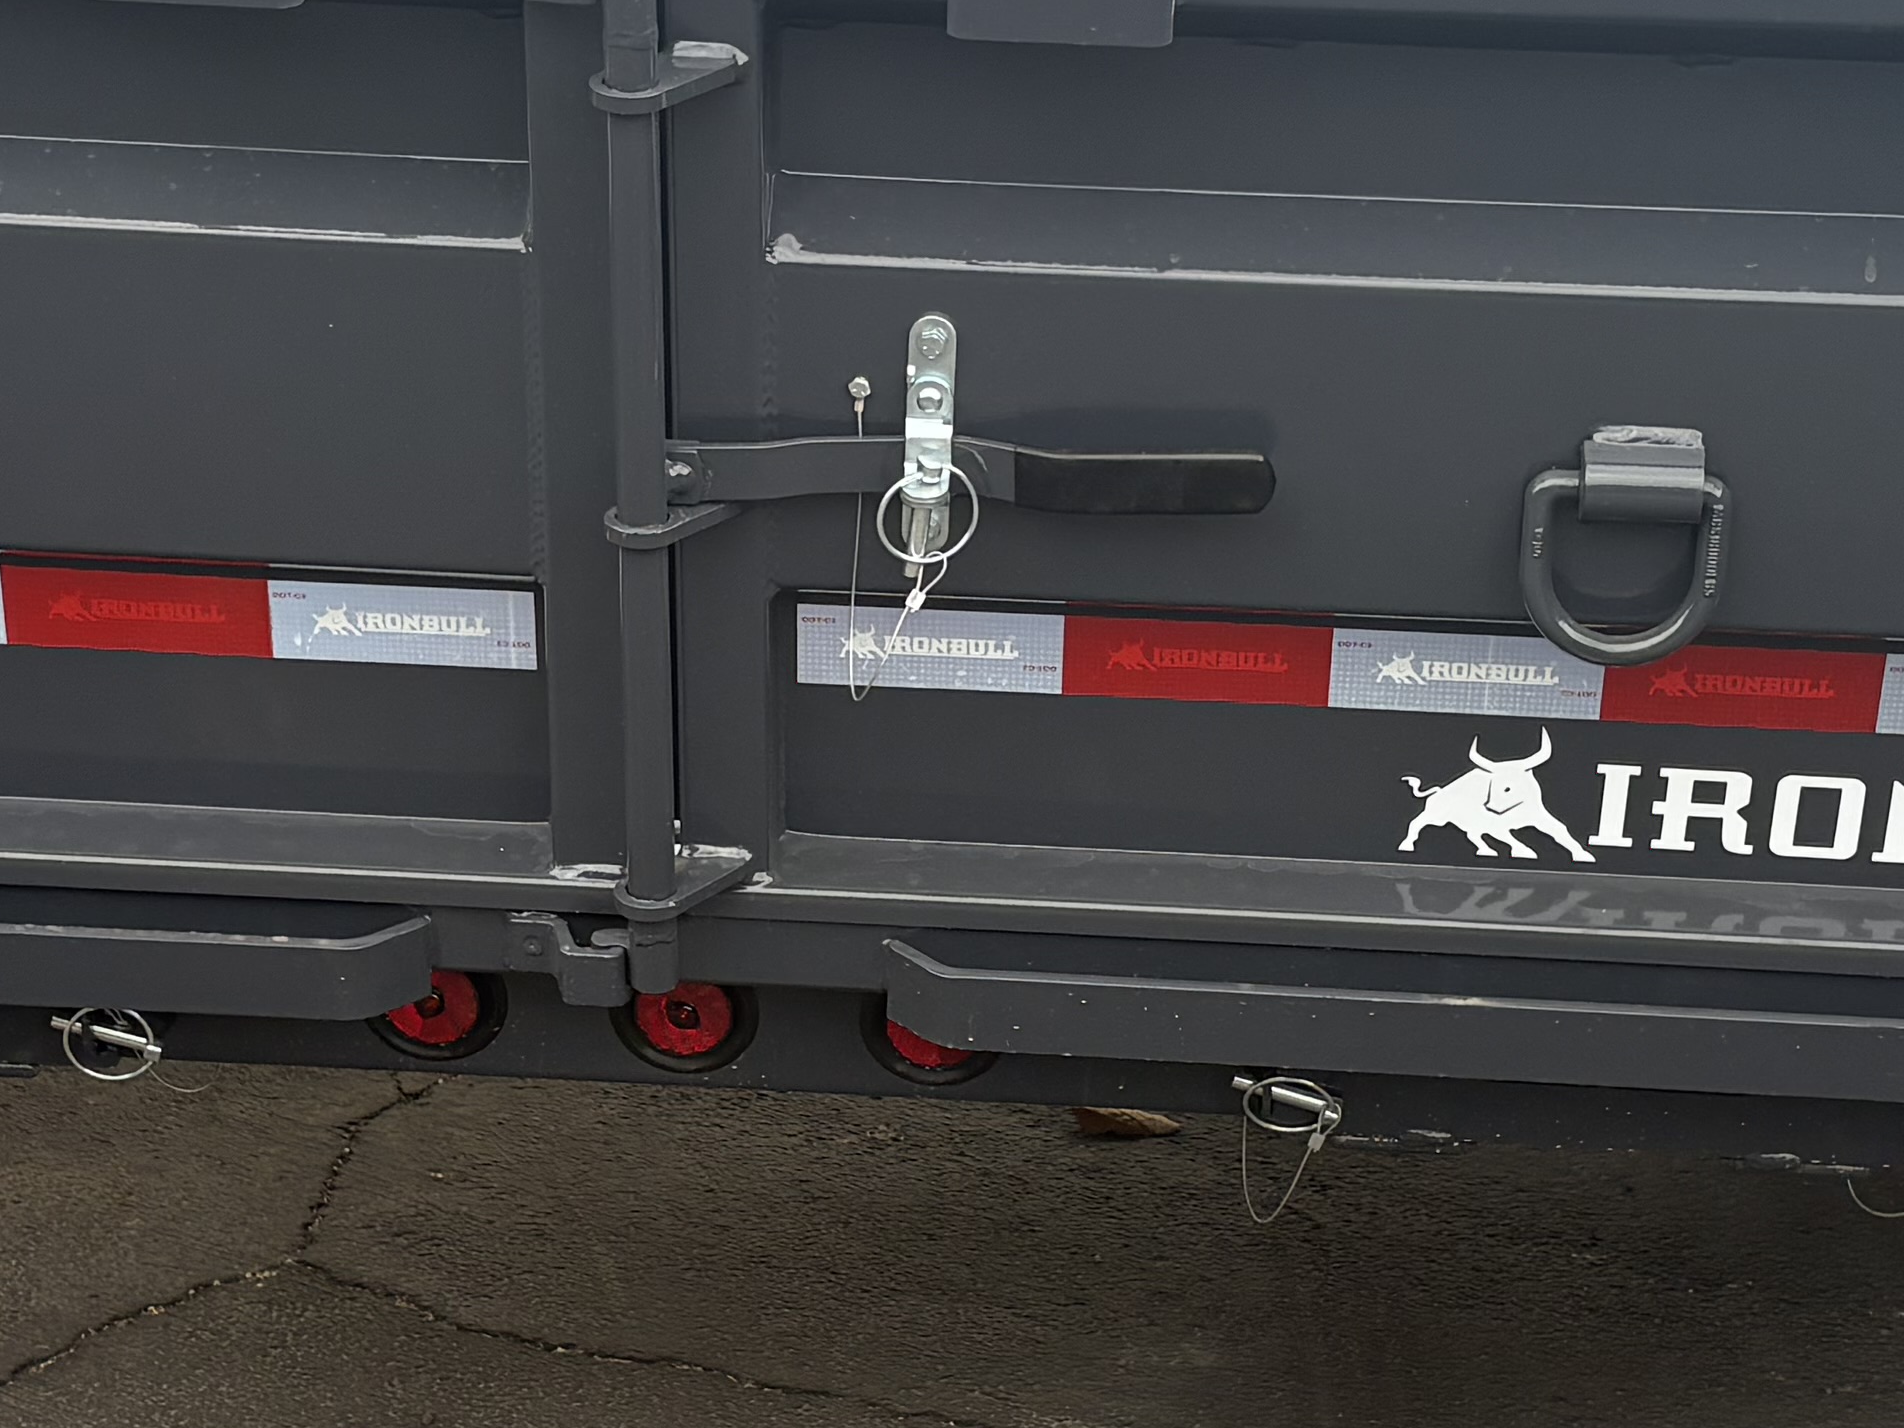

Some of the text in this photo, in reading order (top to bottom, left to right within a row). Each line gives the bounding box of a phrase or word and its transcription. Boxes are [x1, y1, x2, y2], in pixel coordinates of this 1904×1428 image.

[355, 611, 491, 637] IRONBULL
[883, 634, 1019, 660] IRONBULL
[1153, 647, 1289, 673] IRONBULL
[1421, 660, 1559, 686] IRONBULL
[1696, 674, 1836, 699] IRONBULL
